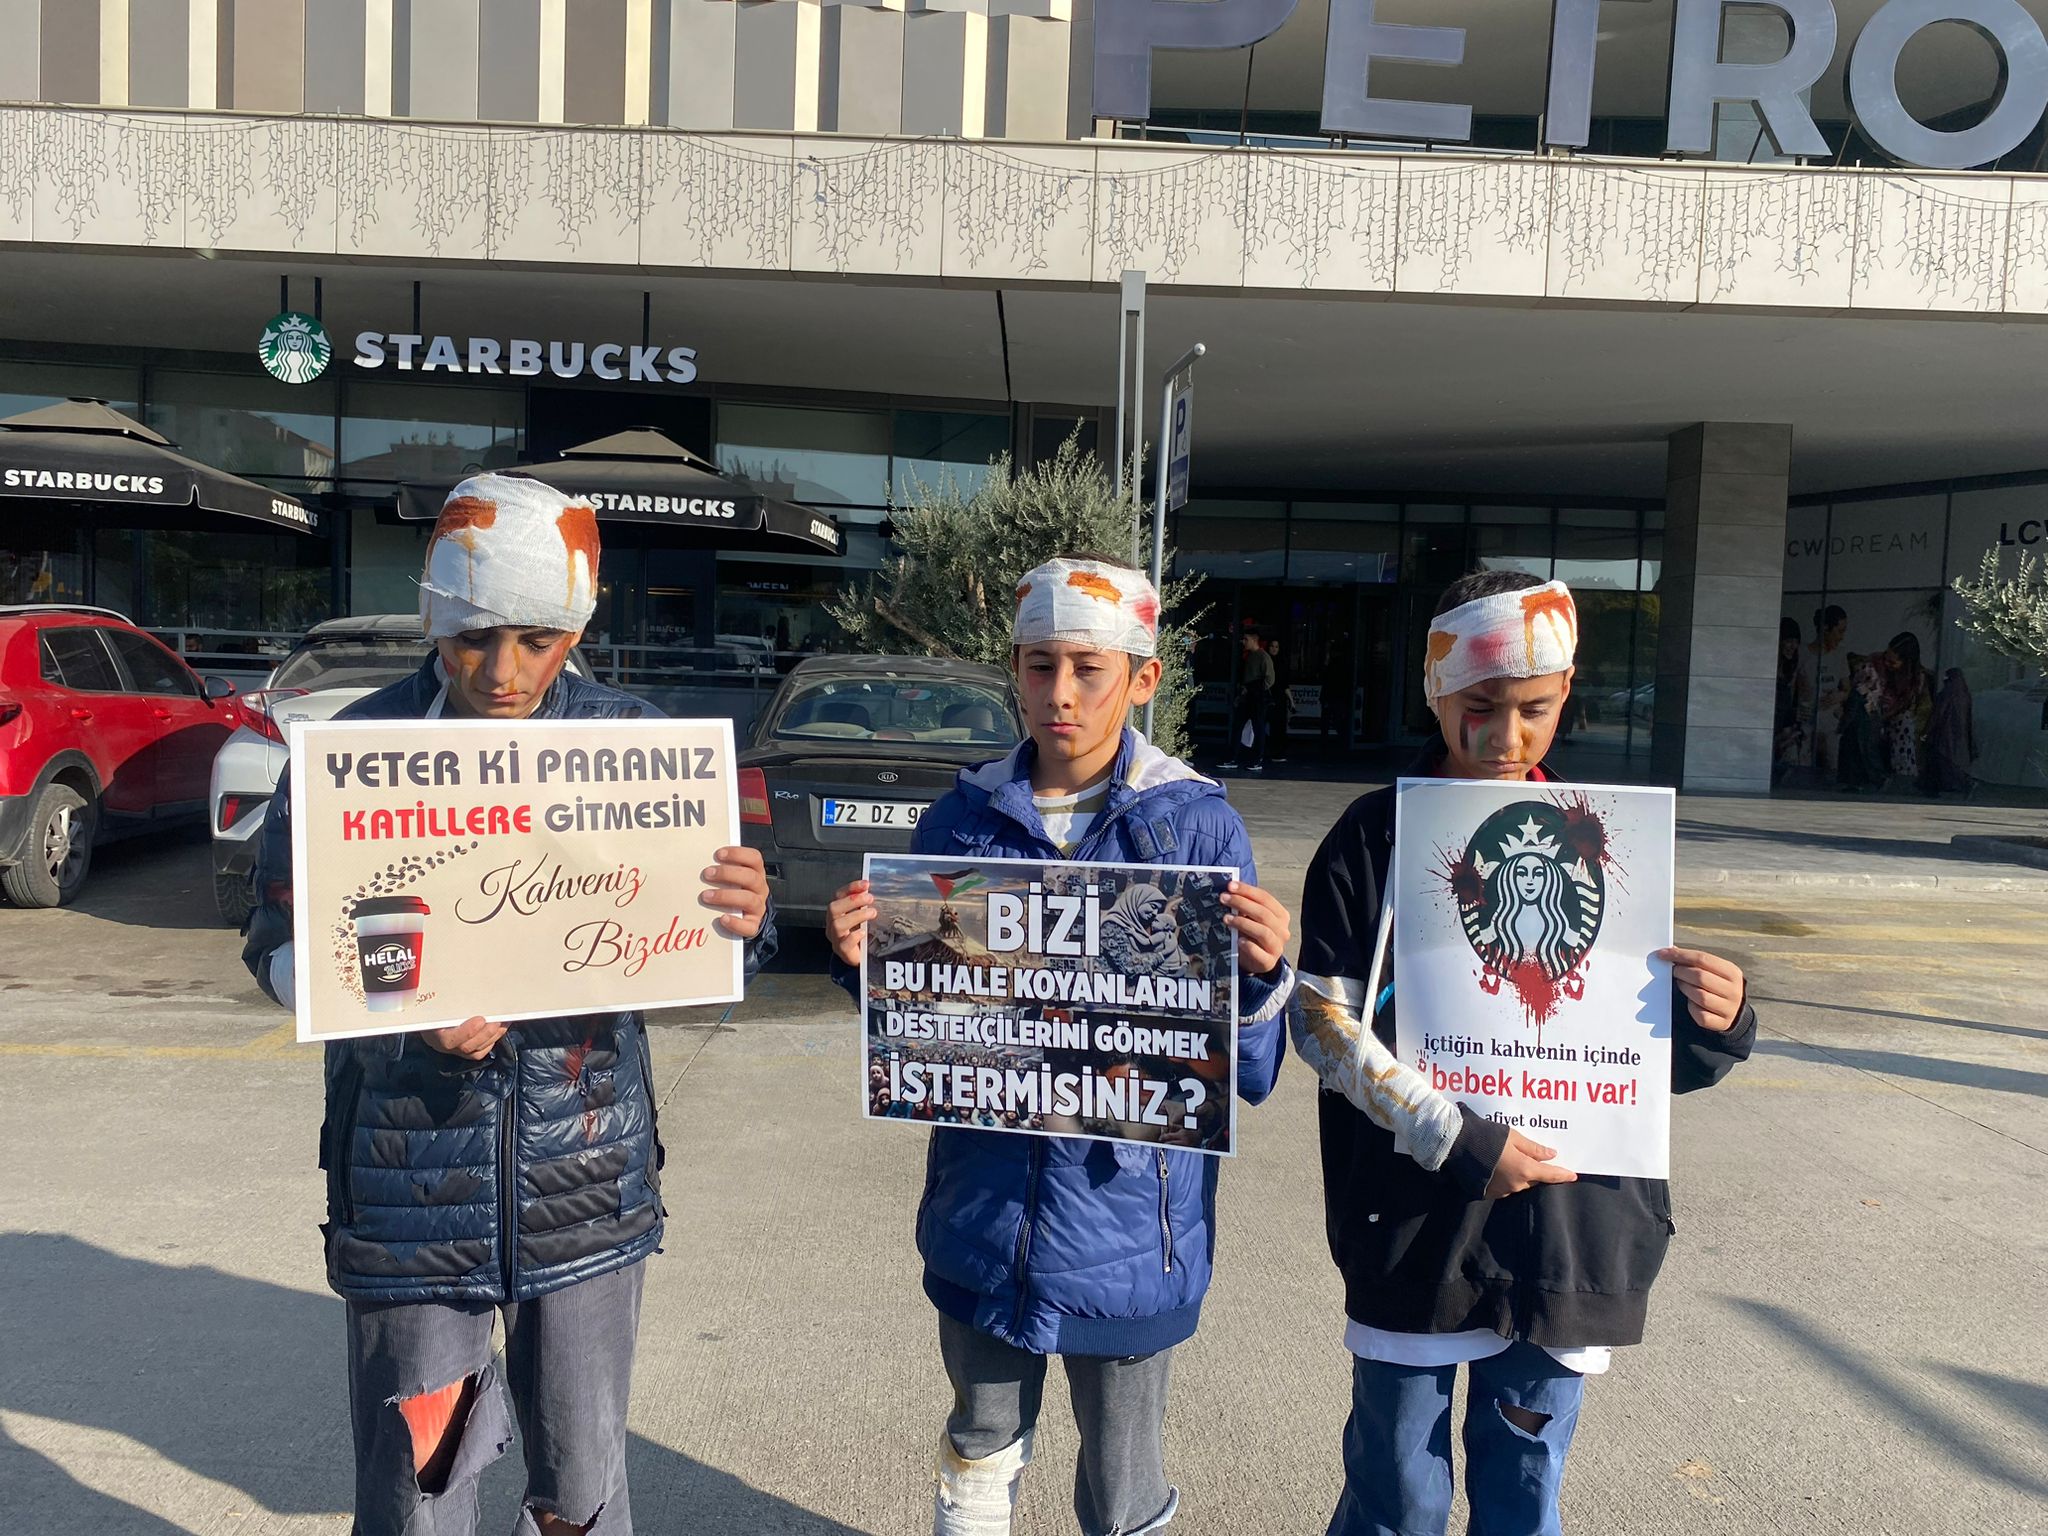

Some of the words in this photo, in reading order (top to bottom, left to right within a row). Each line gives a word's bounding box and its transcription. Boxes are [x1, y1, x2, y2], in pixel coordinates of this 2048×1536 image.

[1091, 0, 2048, 168] PETRO
[353, 331, 698, 384] STARBUCKS
[1174, 398, 1186, 457] P
[4, 469, 164, 494] STARBUCKS
[271, 499, 319, 527] STARBUCKS
[590, 493, 735, 518] STARBUCKS
[1787, 538, 1824, 558] CW
[1830, 532, 1928, 556] DREAM
[325, 750, 461, 788] YETER
[479, 740, 521, 785] Kİ
[537, 747, 717, 783] PARANIZ
[879, 772, 897, 782] KIA
[343, 800, 531, 841] KATİLLERE
[545, 793, 706, 833] GİTMESİN
[774, 790, 800, 800] Rio
[835, 804, 857, 823] 72
[872, 806, 894, 824] DZ
[455, 852, 646, 924] Kahveniz
[986, 882, 1100, 957] BİZİ
[364, 948, 416, 967] HELAL
[563, 915, 707, 977] Bizden
[885, 961, 925, 992] BU
[931, 964, 1007, 998] HALE
[1014, 968, 1211, 1011] KOYANLARIN
[886, 1011, 1088, 1050] DESTEKÇİLERİNİ
[1094, 1022, 1210, 1061] GÖRMEK
[1424, 1033, 1484, 1058] içtiğin
[1490, 1038, 1577, 1061] kahvenin
[1583, 1045, 1641, 1067] içinde
[890, 1052, 1168, 1126] İSTERMİSİNİZ
[1179, 1078, 1206, 1130] ?
[1432, 1063, 1513, 1097] bebek
[1522, 1071, 1577, 1101] kanı
[1587, 1079, 1637, 1105] var!
[1485, 1111, 1525, 1126] afiyet
[1529, 1114, 1568, 1129] olsun
